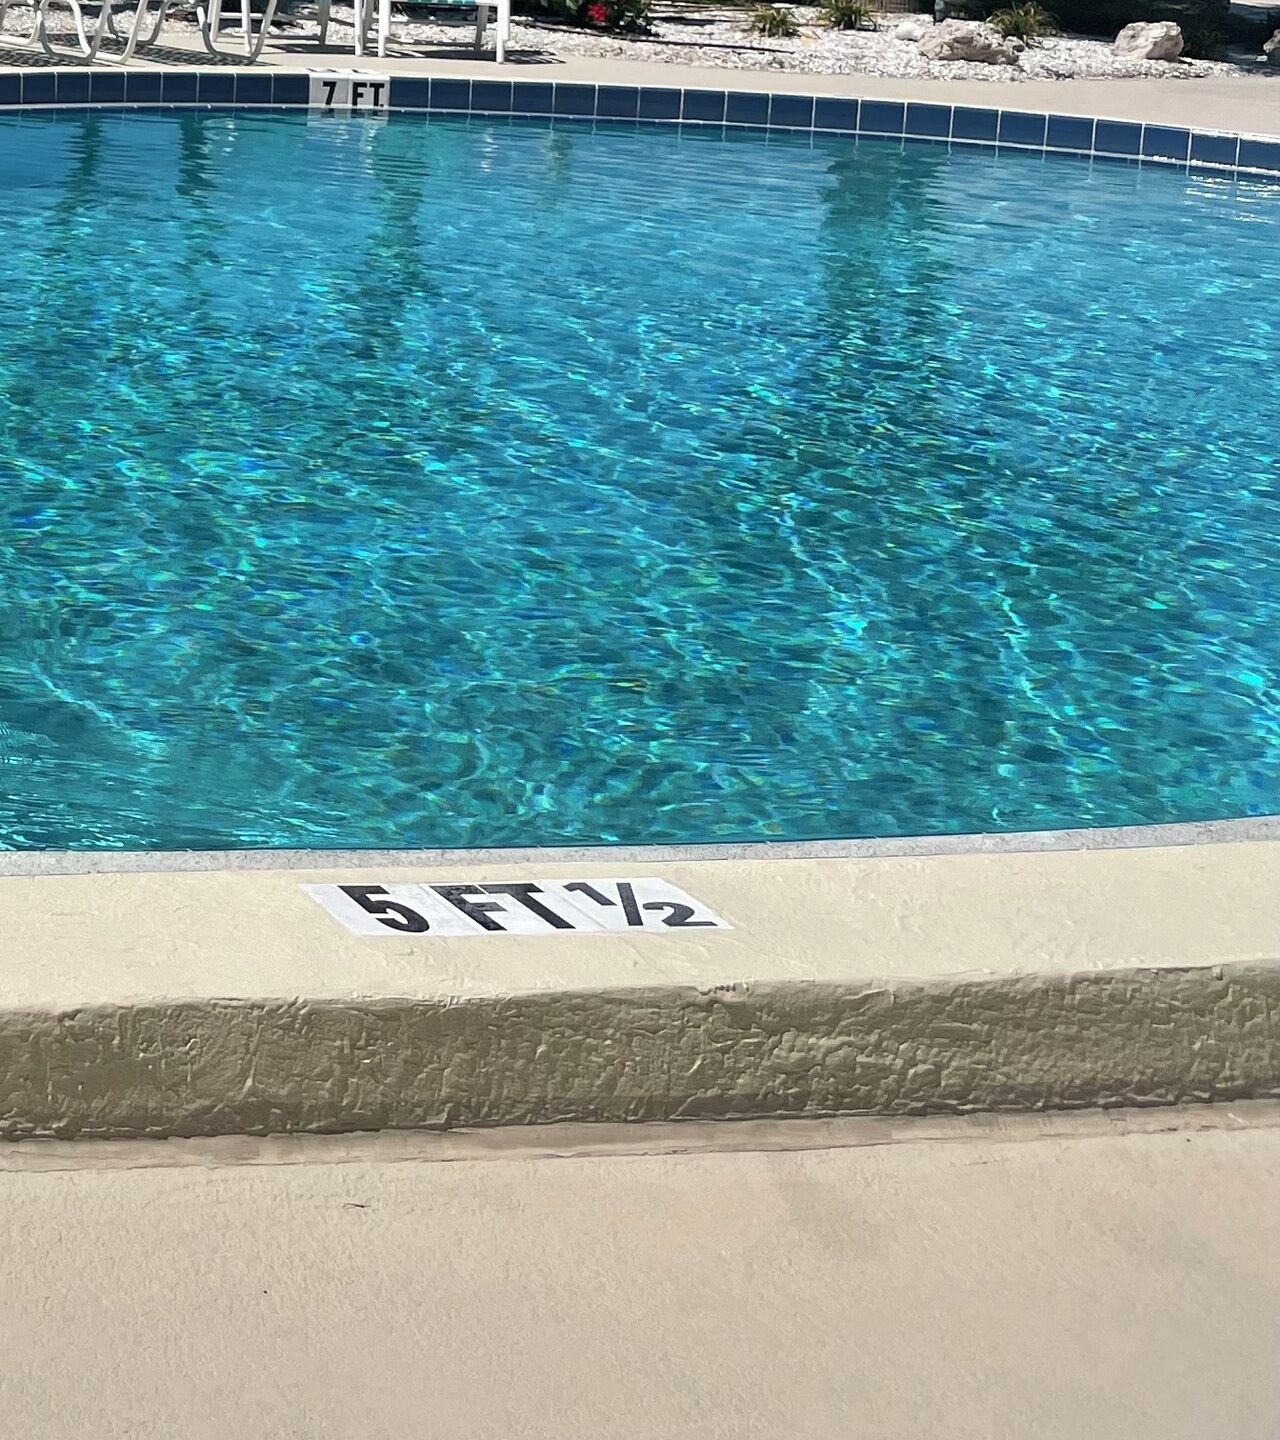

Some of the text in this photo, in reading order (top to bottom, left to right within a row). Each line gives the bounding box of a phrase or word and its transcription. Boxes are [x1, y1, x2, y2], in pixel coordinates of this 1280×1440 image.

[322, 81, 337, 105] 7
[336, 884, 430, 933] 5
[428, 882, 576, 932] FT
